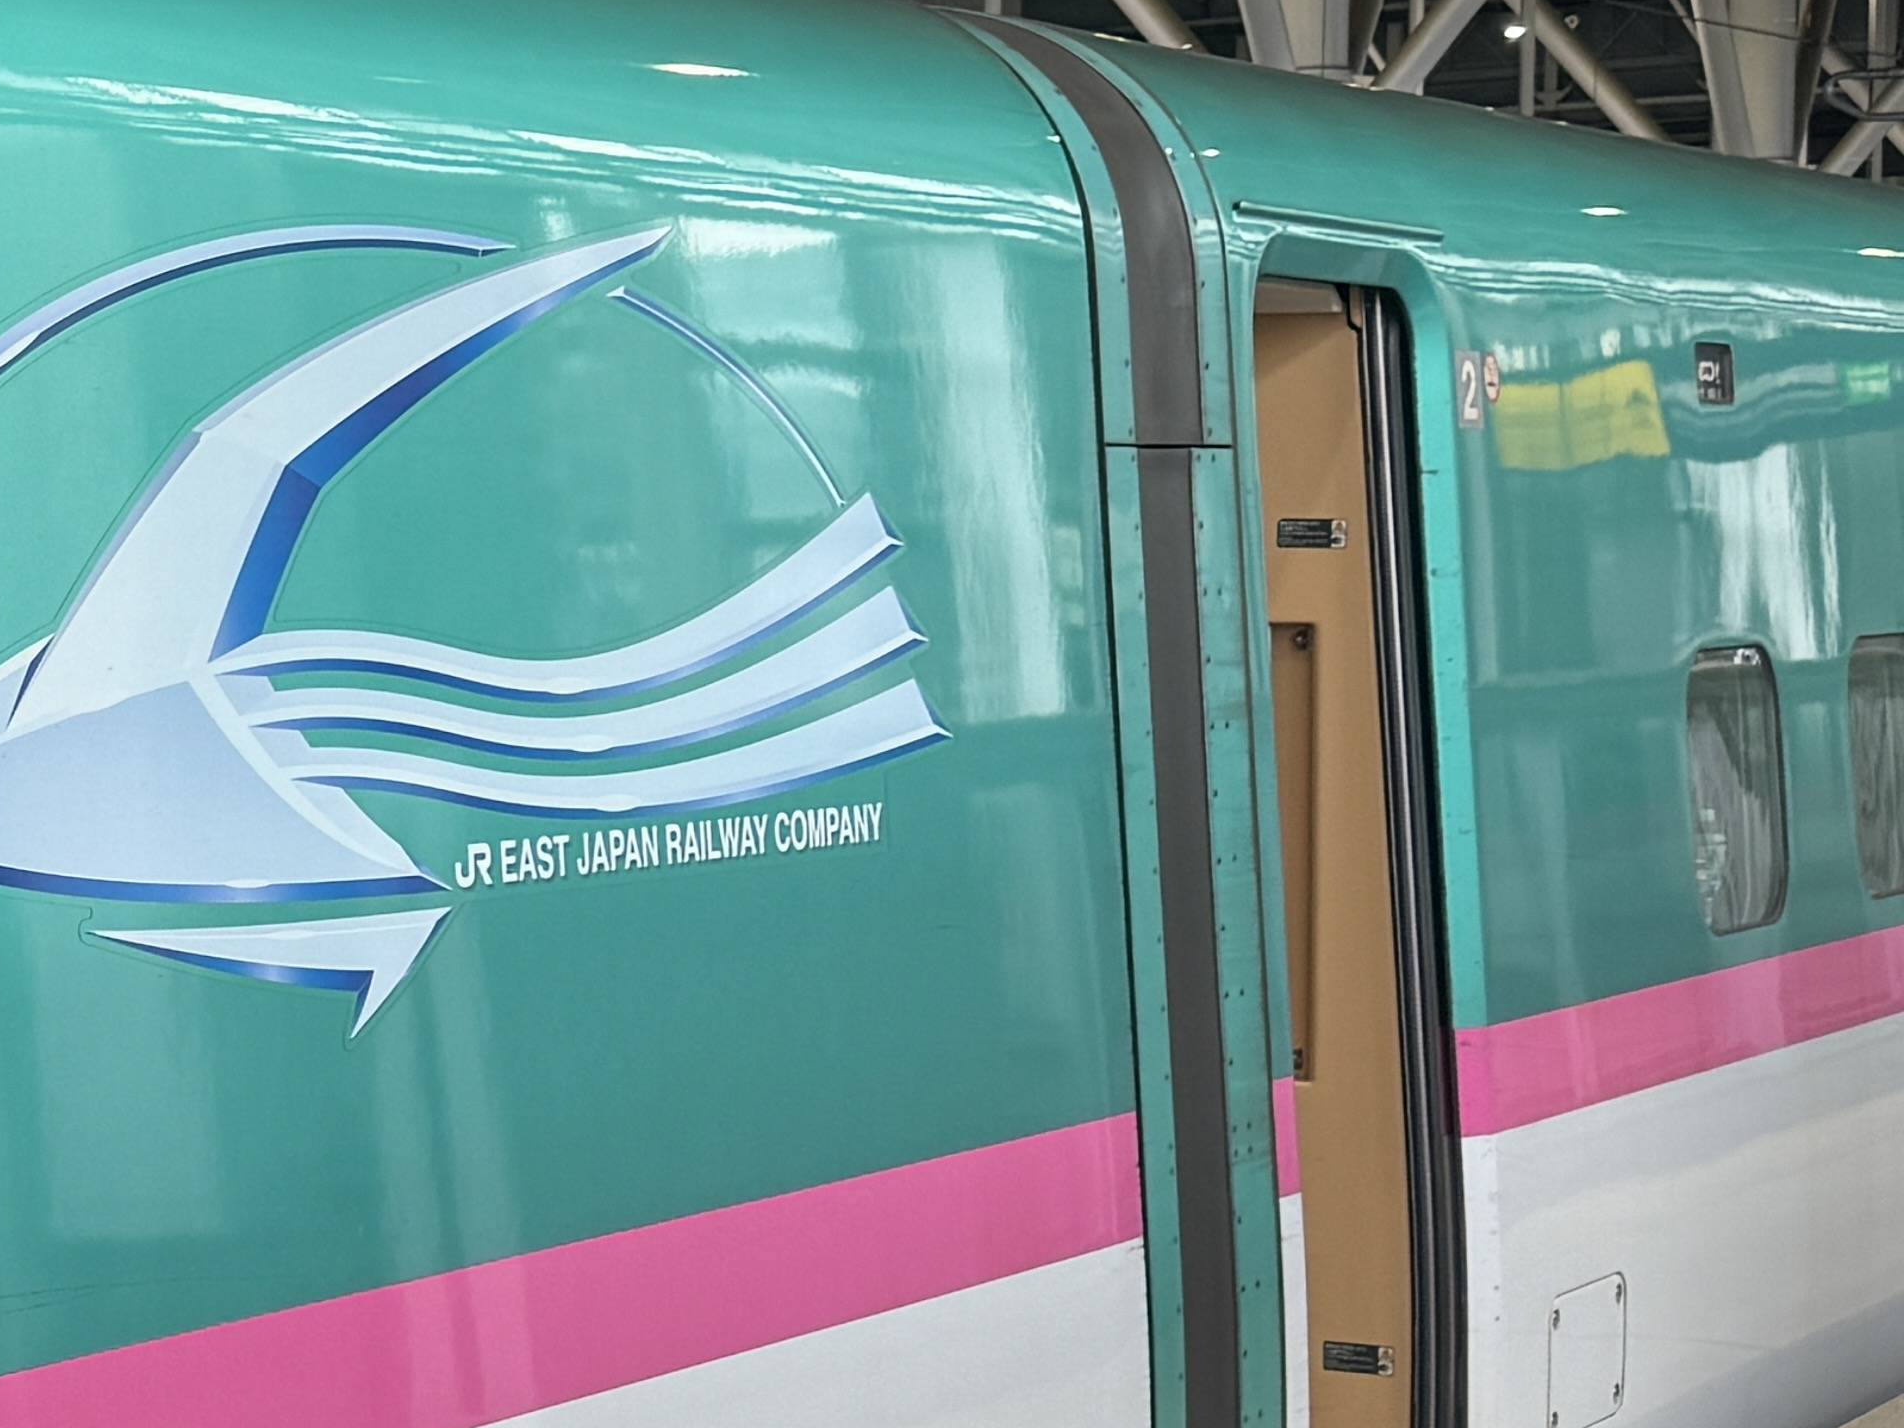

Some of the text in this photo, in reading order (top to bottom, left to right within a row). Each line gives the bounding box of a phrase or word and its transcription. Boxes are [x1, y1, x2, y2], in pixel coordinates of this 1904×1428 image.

[1460, 359, 1480, 421] 2
[454, 802, 883, 888] JR EAST JAPAN RAILWAY COMPANY
